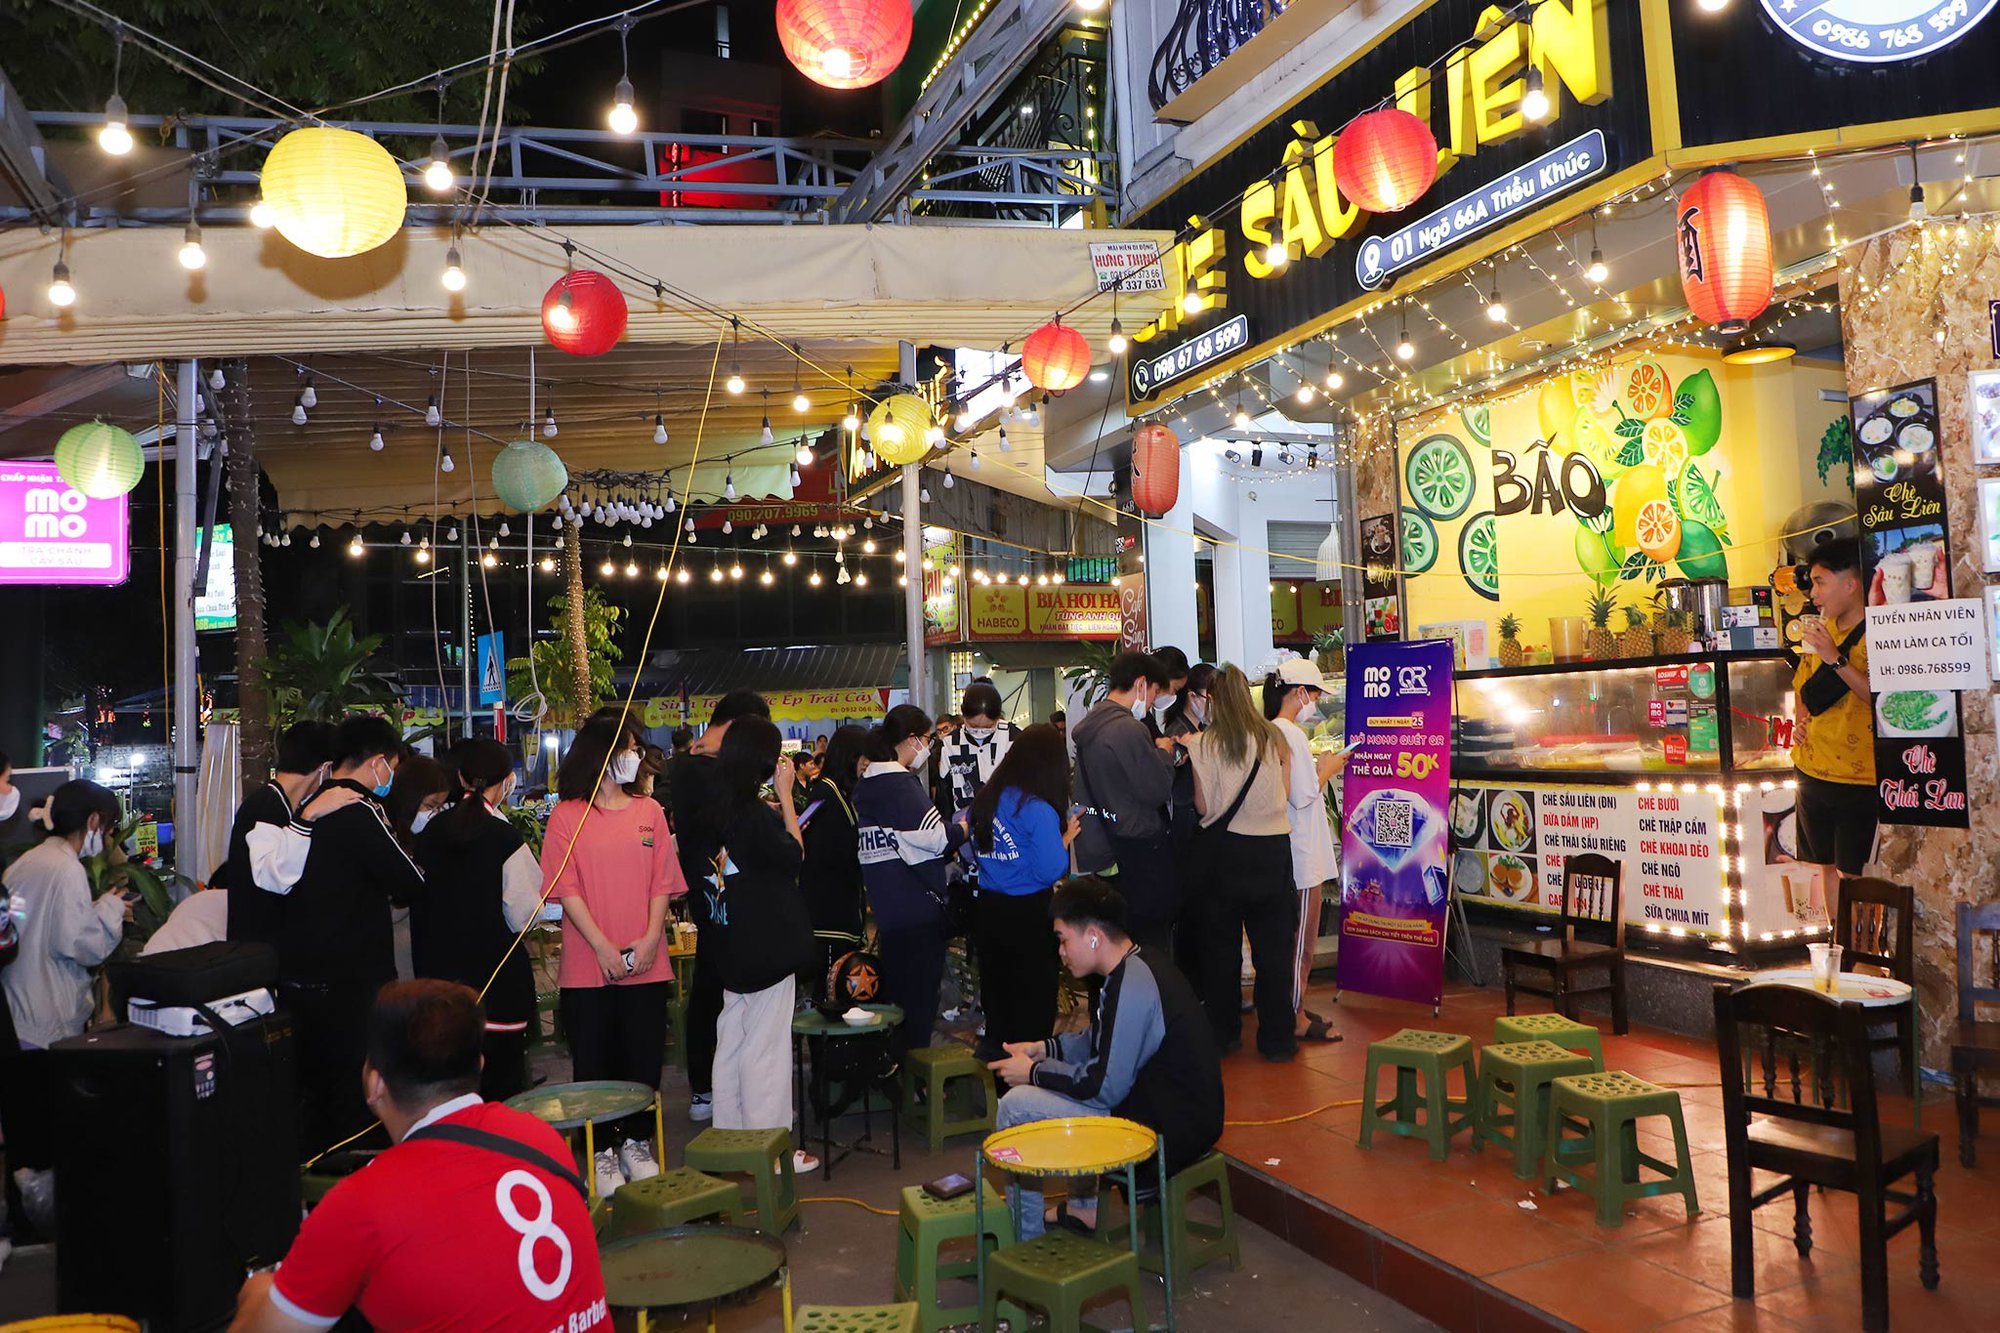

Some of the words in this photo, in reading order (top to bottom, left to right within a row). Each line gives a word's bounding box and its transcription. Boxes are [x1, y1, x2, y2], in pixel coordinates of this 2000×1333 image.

[1812, 19, 1871, 49] 0986
[1879, 23, 1923, 49] 768
[1927, 0, 1968, 33] 599
[1390, 229, 1413, 262] 01
[1419, 216, 1450, 249] Ngõ
[1454, 200, 1488, 230] 66A
[1491, 175, 1535, 210] Triều
[1539, 151, 1591, 189] Khúc
[1094, 252, 1124, 268] HƯNG
[1125, 280, 1143, 290] 337
[1145, 279, 1162, 290] 631
[1153, 355, 1175, 383] 098
[1177, 343, 1193, 370] 67
[1195, 339, 1213, 361] 68
[1215, 322, 1241, 352] 599
[1884, 482, 1916, 503] Chè
[1901, 496, 1941, 519] Liên
[1036, 592, 1065, 608] BIA
[1085, 610, 1106, 621] ANH
[1909, 609, 1941, 622] NHÂN
[1945, 607, 1975, 619] VIÊN
[977, 618, 1020, 629] HABECO
[1875, 640, 1901, 650] NAM
[1904, 636, 1928, 648] LÀM
[1932, 637, 1947, 646] CA
[1950, 632, 1972, 646] TỐI
[1880, 665, 1895, 676] LH:
[1898, 662, 1971, 675] 0986.768599
[1412, 717, 1424, 726] 25
[1367, 734, 1398, 746] MOMO
[1399, 732, 1427, 746] QUÉT
[1428, 734, 1445, 746] QR
[1372, 764, 1393, 776] QUÀ
[1542, 792, 1558, 806] CHÈ
[1577, 793, 1596, 808] LIÊN
[1638, 795, 1655, 810] CHÈ
[1581, 816, 1599, 830] (HP)
[1639, 816, 1656, 832] CHÈ
[1659, 817, 1682, 836] THẬP
[1544, 832, 1560, 846] CHÈ
[1561, 833, 1579, 848] THÁI
[1600, 836, 1626, 852] RIÊNG
[1640, 839, 1657, 854] CHÈ
[1660, 842, 1688, 856] KHOAI
[1690, 840, 1709, 858] DẺO
[1545, 852, 1561, 867] CHÈ
[1642, 860, 1659, 875] CHÈ
[1661, 862, 1681, 878] NGÔ
[1547, 872, 1562, 886] CHÈ
[1643, 883, 1660, 897] CHÈ
[1663, 884, 1684, 900] THÁI
[1645, 903, 1663, 919] SỮA
[1665, 908, 1690, 923] CHUA
[1692, 910, 1709, 925] MÍT
[495, 1169, 572, 1301] 8
